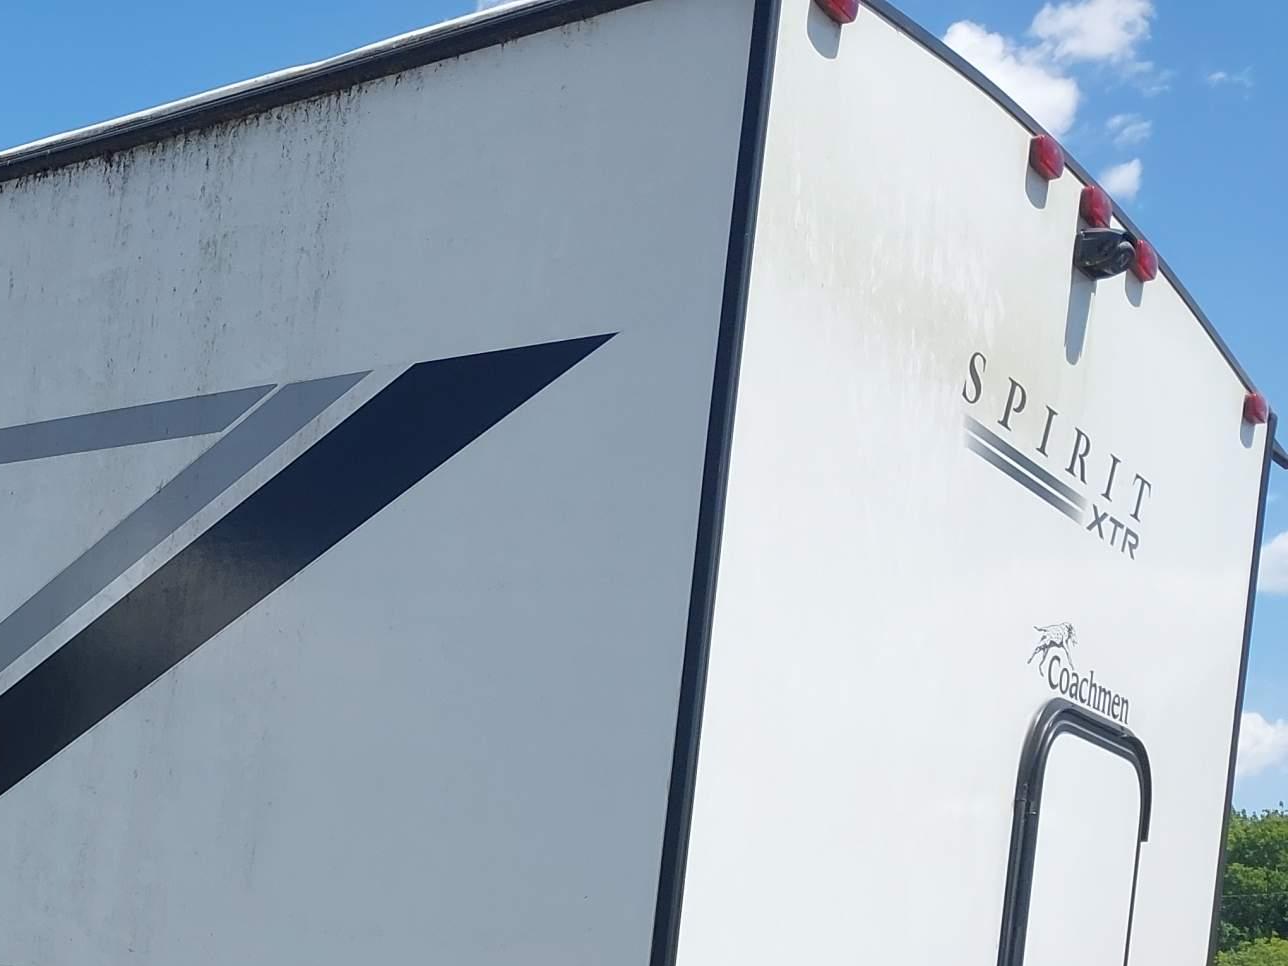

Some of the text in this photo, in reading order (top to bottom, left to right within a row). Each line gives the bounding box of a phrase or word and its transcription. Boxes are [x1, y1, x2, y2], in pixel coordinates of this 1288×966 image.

[962, 352, 1152, 523] SPIRIT
[1086, 504, 1140, 560] XTR
[1048, 656, 1129, 725] Coachmen
